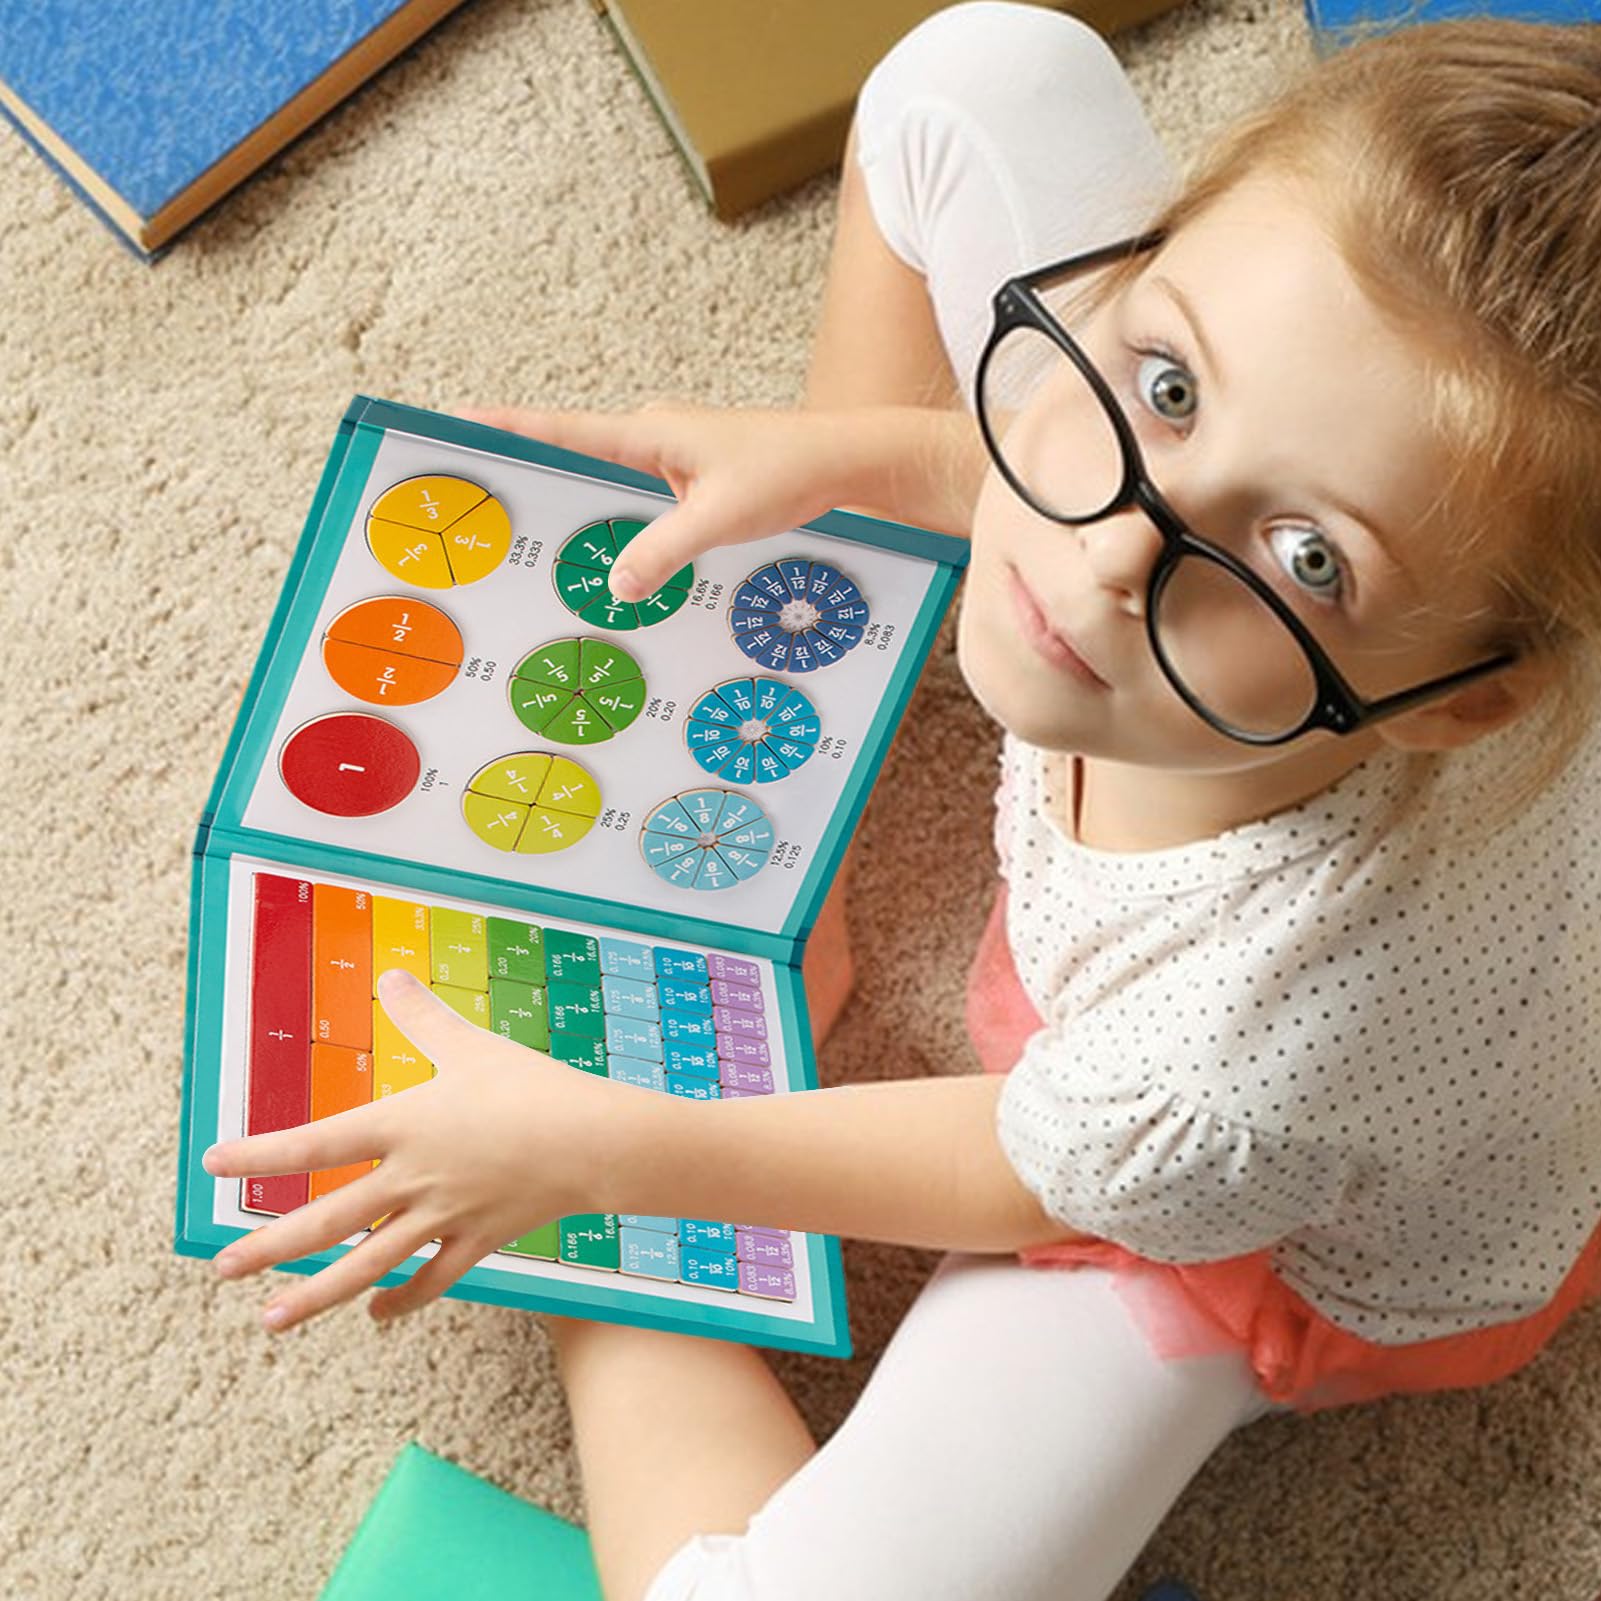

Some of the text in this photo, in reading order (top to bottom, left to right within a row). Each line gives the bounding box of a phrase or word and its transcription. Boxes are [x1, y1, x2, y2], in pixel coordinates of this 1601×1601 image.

[508, 536, 529, 566] 33.3%
[525, 540, 544, 567] 0.333
[691, 578, 710, 606] 16.6%
[705, 584, 723, 610] 0.166
[864, 623, 880, 645] 8.3%
[877, 625, 894, 650] 0.083
[466, 657, 481, 678] 50%
[480, 661, 497, 682] 0.50
[646, 697, 662, 718] 20%
[661, 701, 677, 721] 0.20
[818, 736, 833, 755] 10%
[832, 739, 847, 759] 0.10
[338, 763, 365, 772] 1
[421, 768, 438, 792] 100%
[601, 808, 616, 828] 25%
[615, 811, 631, 831] 0.25
[771, 840, 789, 866] 12.5%
[784, 845, 802, 869] 0.125
